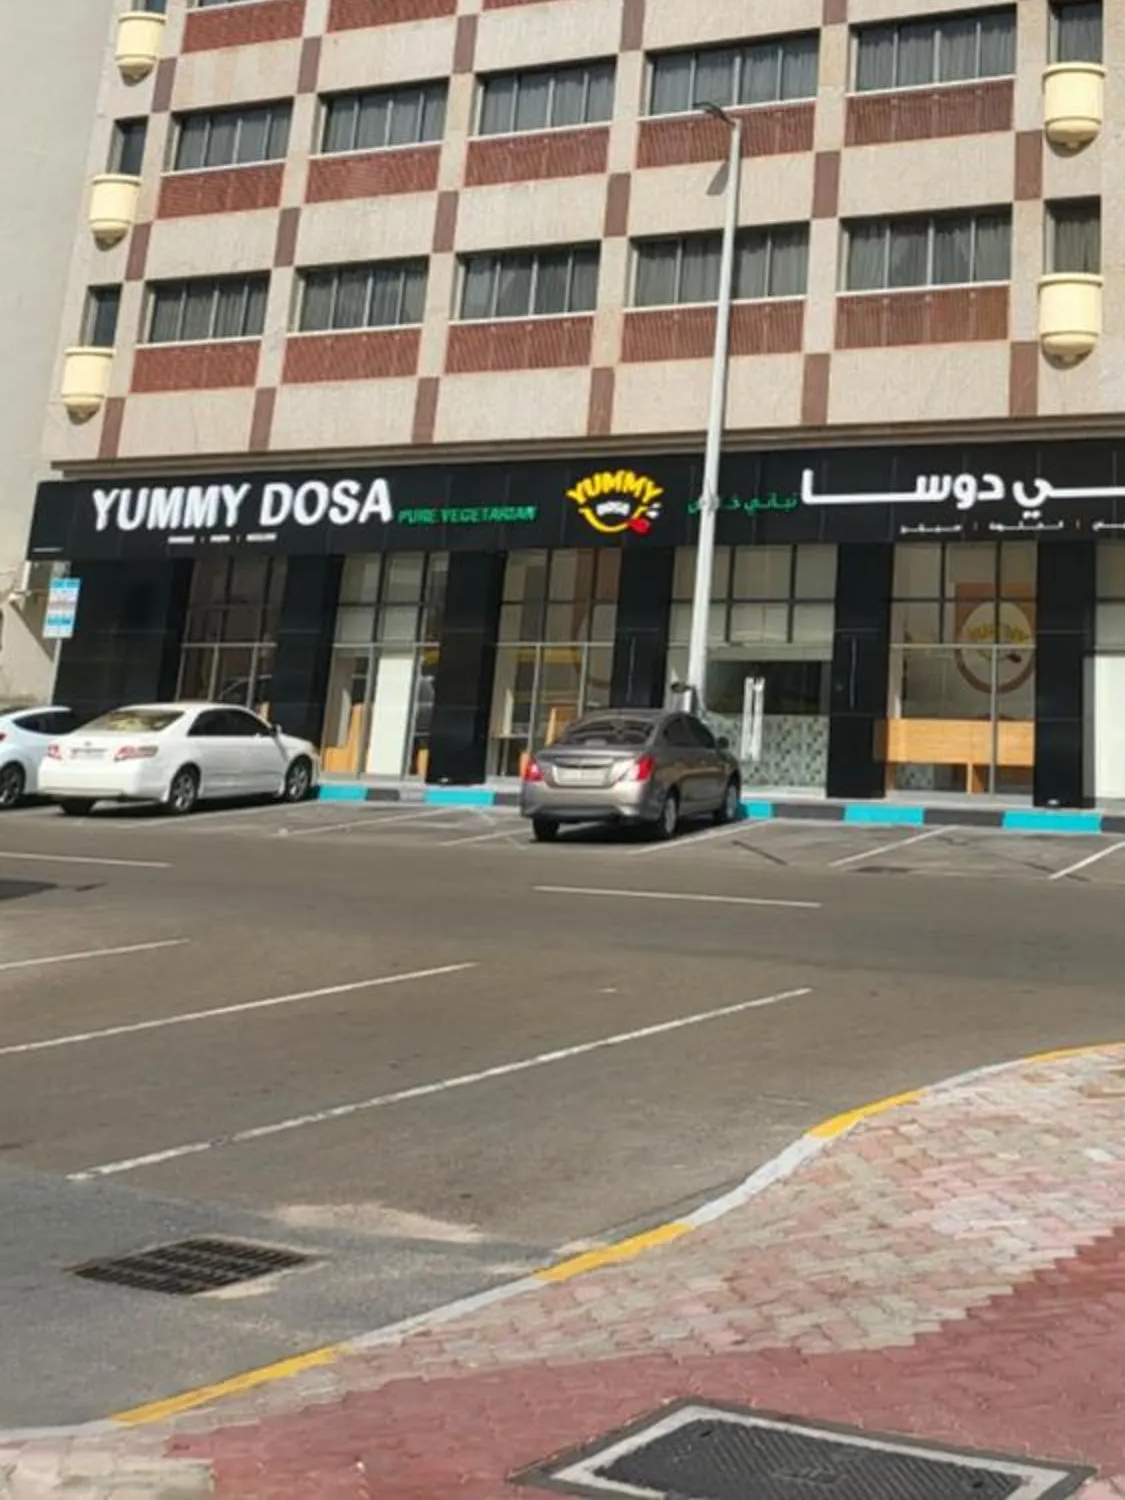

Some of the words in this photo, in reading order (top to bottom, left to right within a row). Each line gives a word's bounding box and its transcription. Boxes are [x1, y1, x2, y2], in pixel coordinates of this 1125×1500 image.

[92, 482, 252, 532] YUMMY
[259, 477, 394, 527] DOSA
[565, 469, 664, 504] YUMMY
